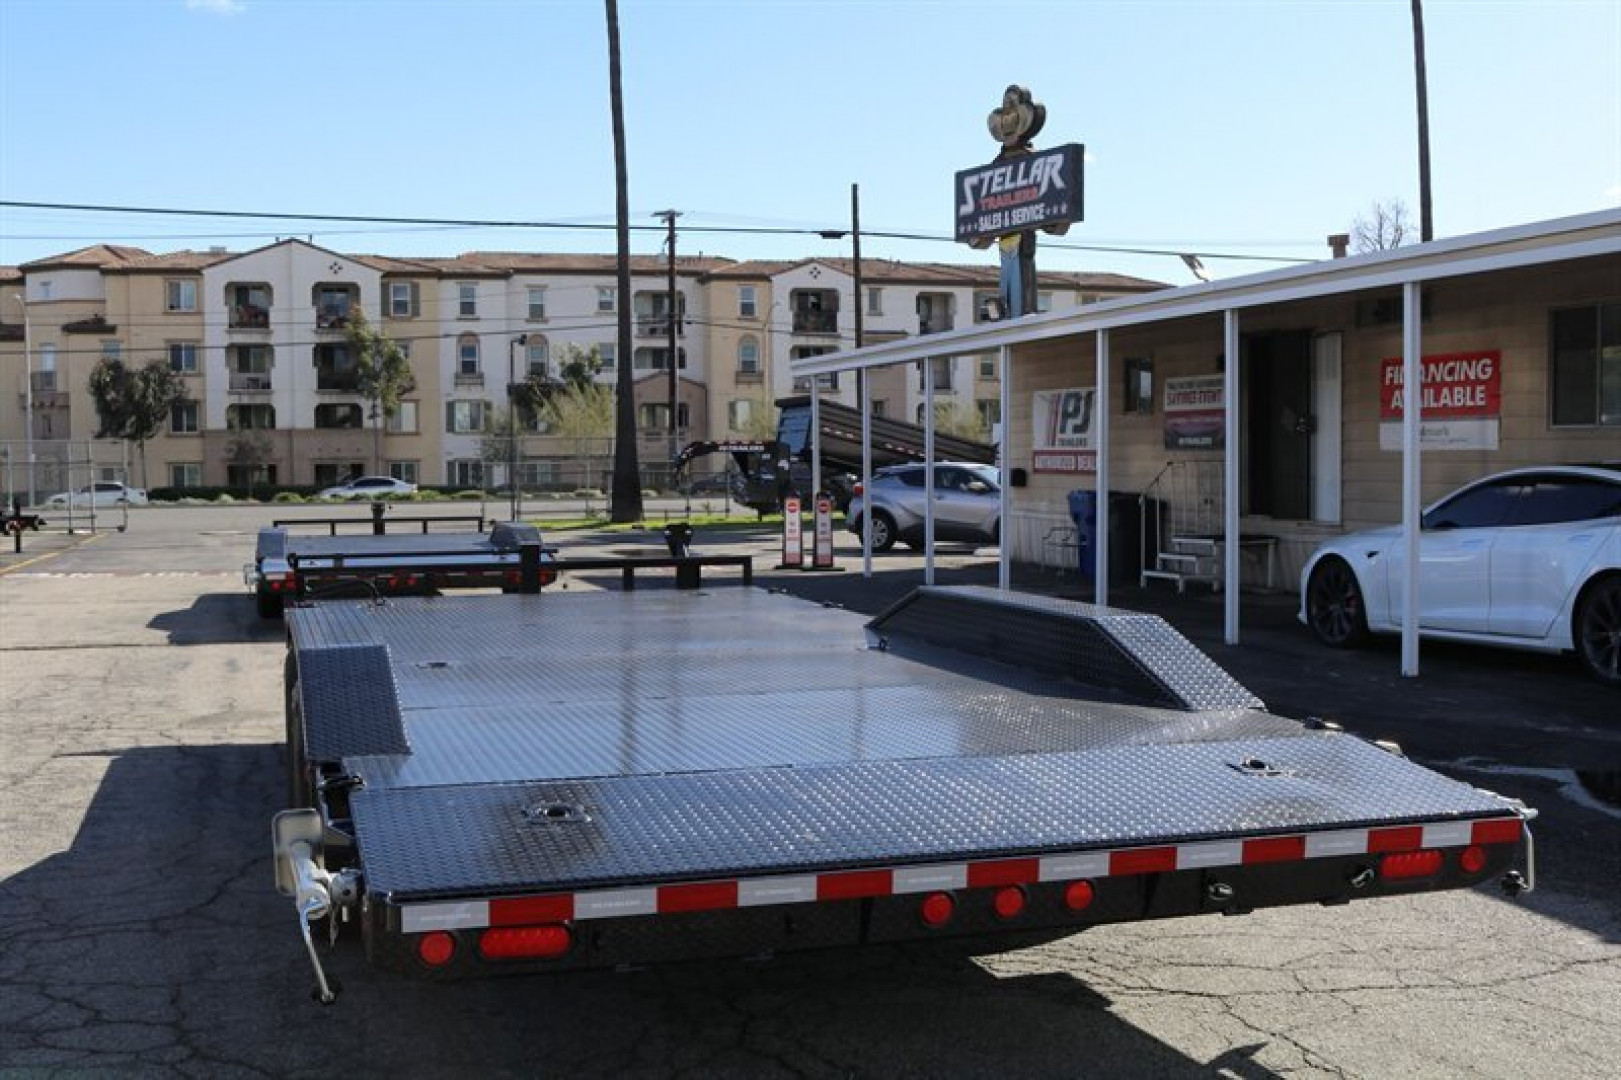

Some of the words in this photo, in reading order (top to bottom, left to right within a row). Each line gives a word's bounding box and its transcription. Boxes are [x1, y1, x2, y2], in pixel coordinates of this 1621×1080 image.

[960, 153, 1067, 216] STELLAR
[979, 212, 1001, 232] SALES
[1059, 391, 1094, 434] PJ
[1391, 384, 1486, 410] AILABLE
